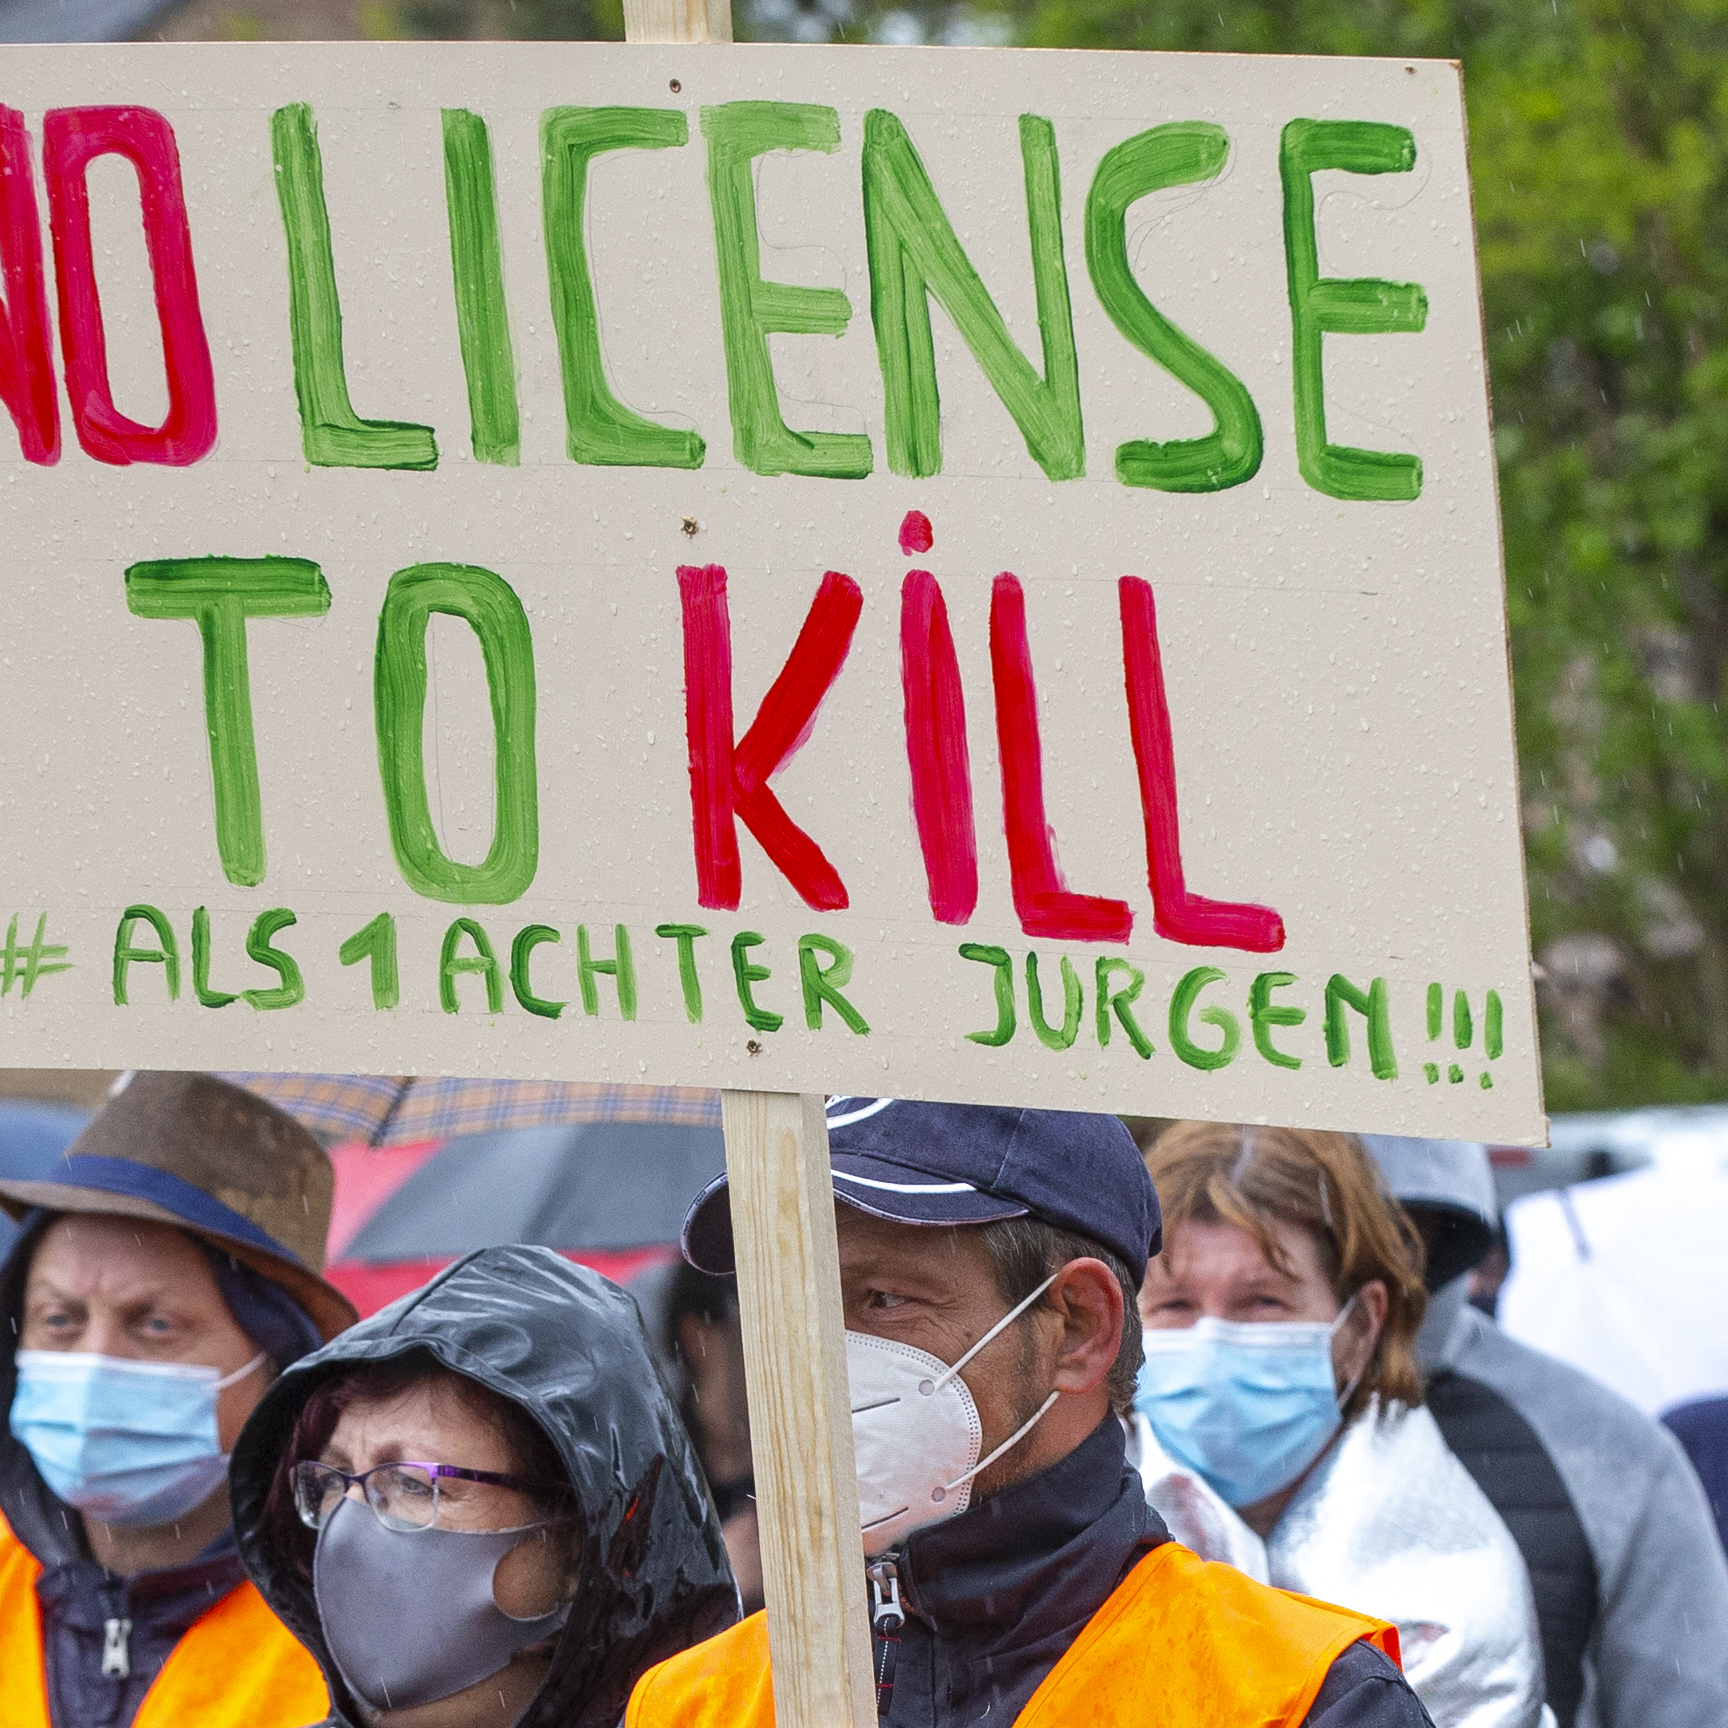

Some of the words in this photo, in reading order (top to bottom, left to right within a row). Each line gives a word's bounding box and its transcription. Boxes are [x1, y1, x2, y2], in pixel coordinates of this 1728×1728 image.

[270, 99, 1428, 501] LICENSE
[124, 554, 539, 905] TO
[438, 917, 870, 1035] ACHTER
